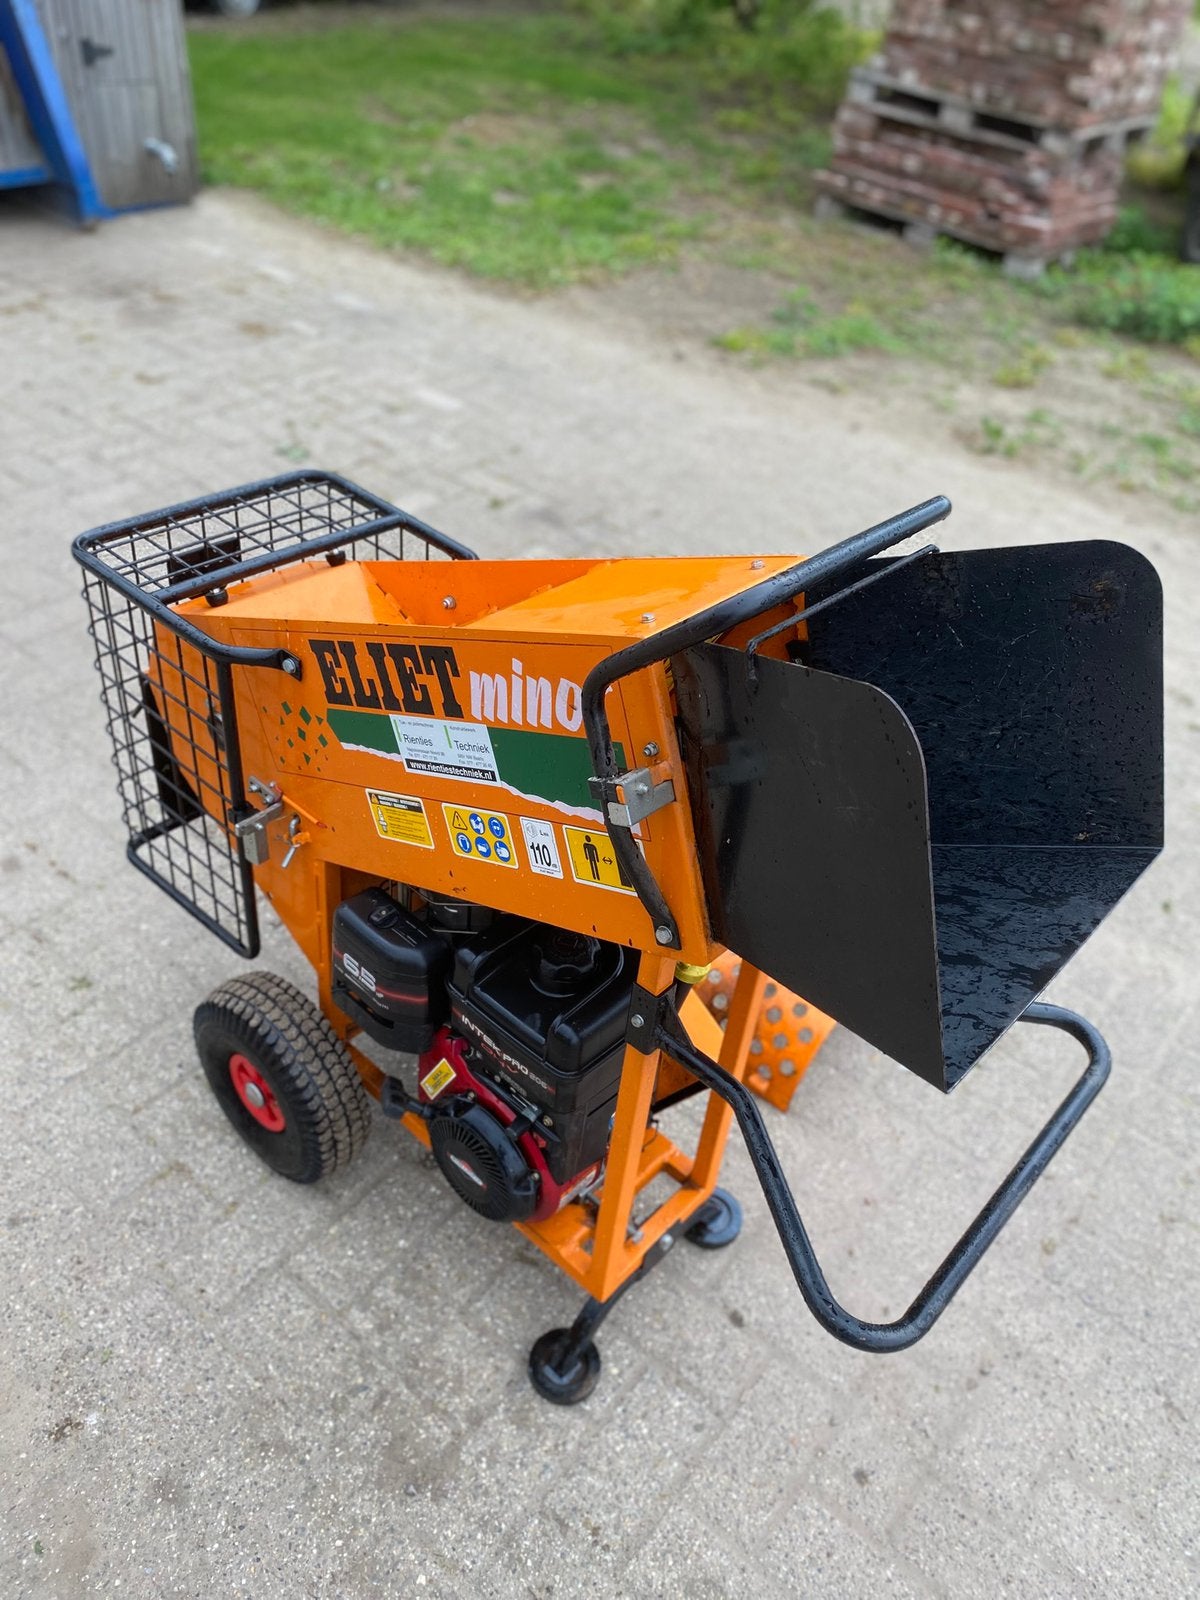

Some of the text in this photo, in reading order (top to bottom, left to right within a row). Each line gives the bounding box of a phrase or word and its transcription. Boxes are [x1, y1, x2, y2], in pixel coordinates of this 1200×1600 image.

[308, 639, 612, 732] ELIET mino
[453, 740, 490, 754] Techniek
[409, 761, 493, 780] www.rientiestechniek.nl
[530, 841, 552, 867] 110
[462, 1015, 501, 1057] INTEK
[502, 1053, 529, 1075] PRO
